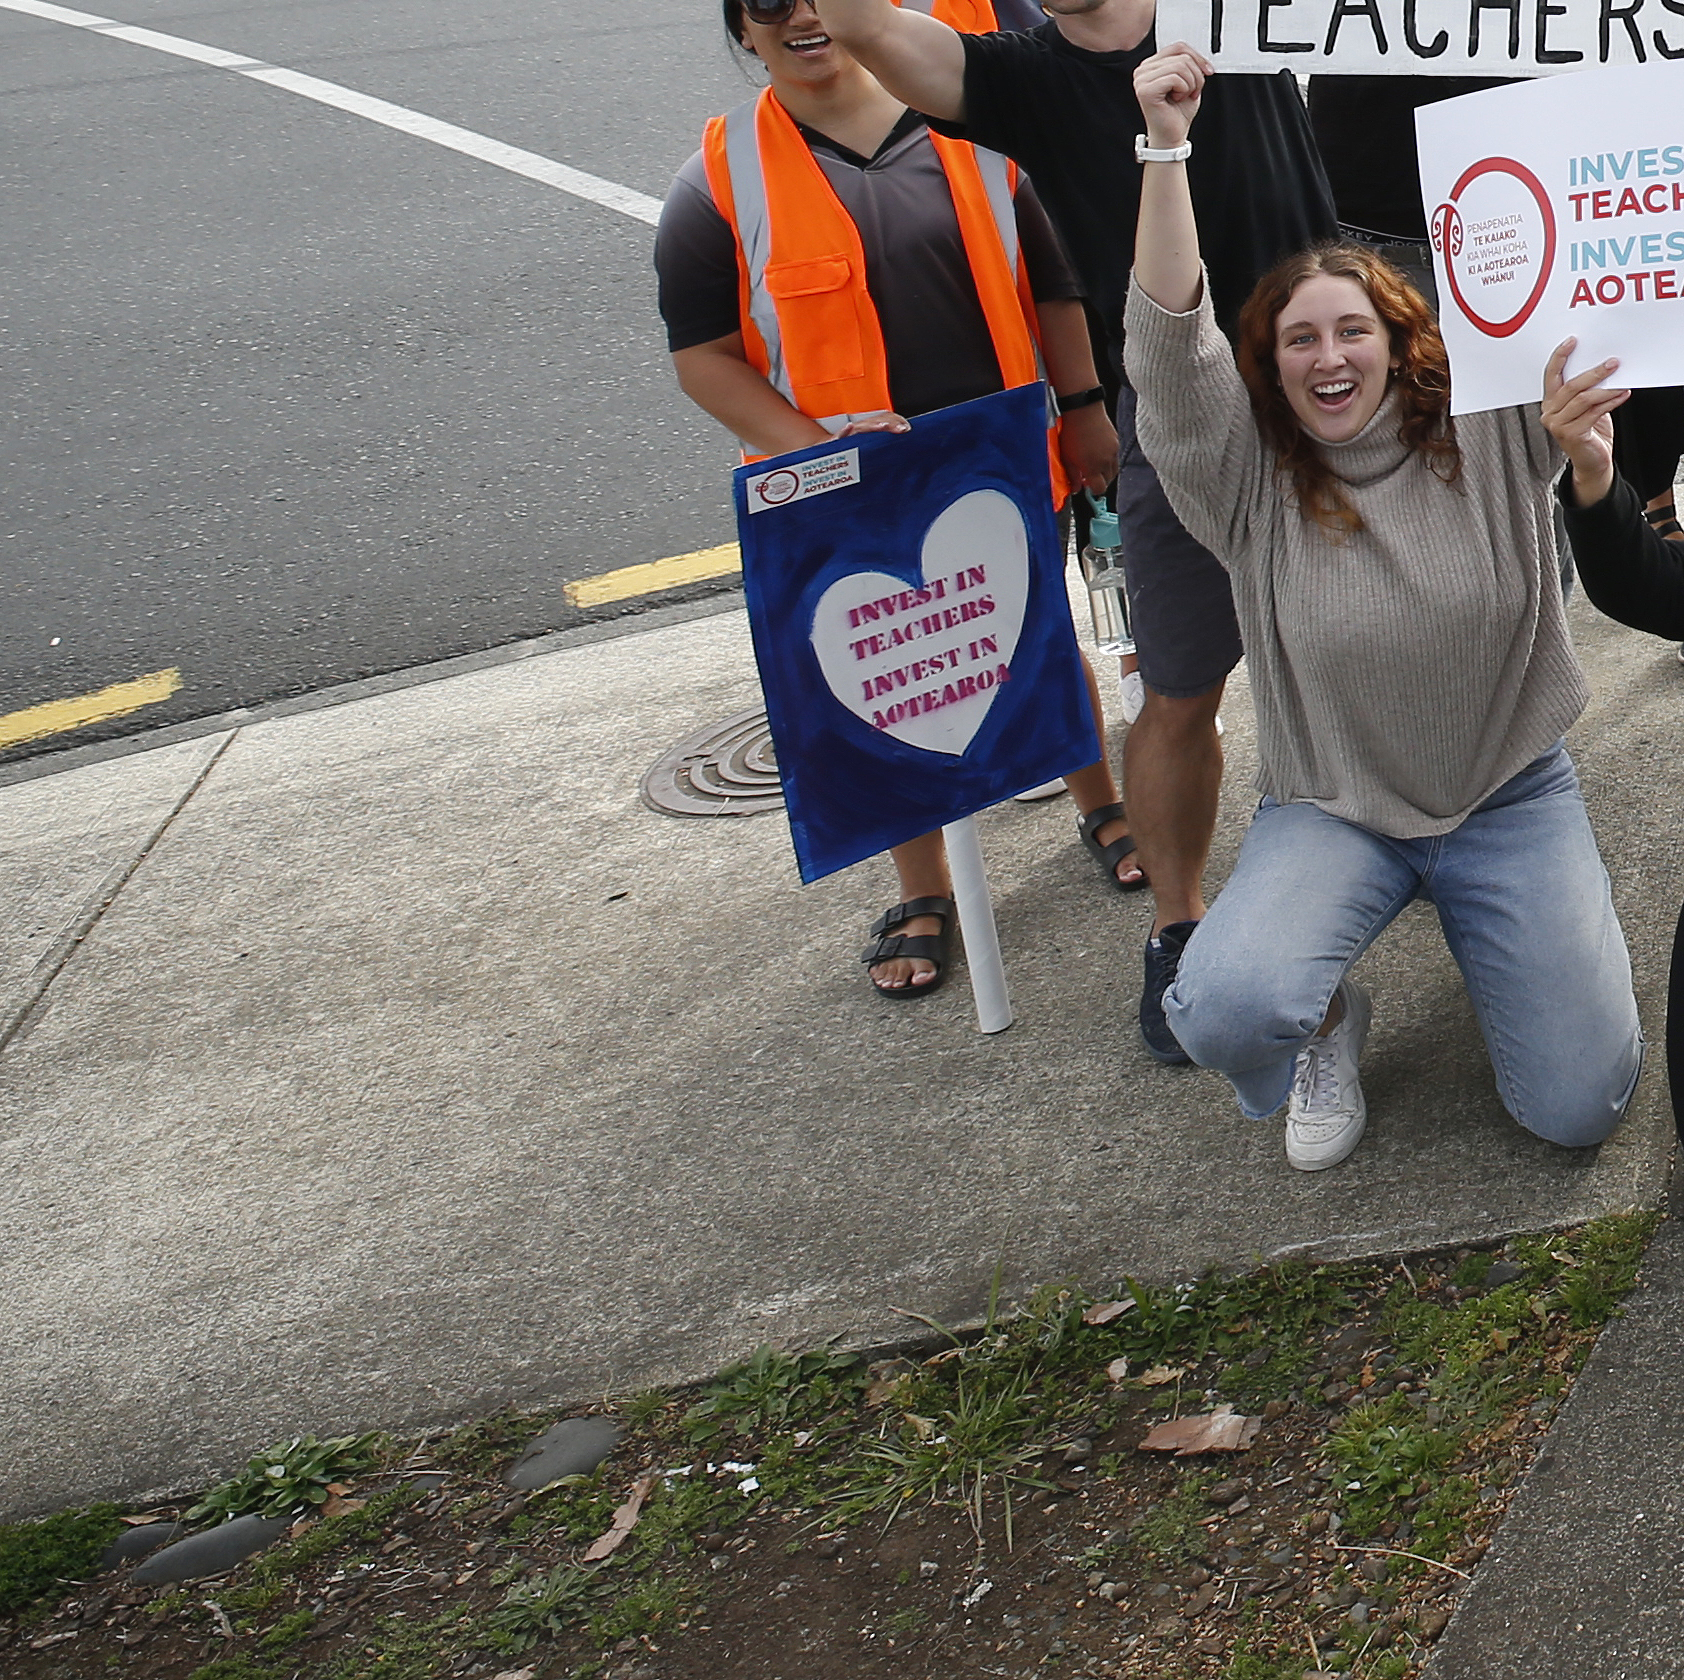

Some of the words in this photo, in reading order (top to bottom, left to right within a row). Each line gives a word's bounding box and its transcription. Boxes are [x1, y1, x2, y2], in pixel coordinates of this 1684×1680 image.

[848, 578, 948, 628] INVEST
[956, 564, 986, 591] IN
[850, 594, 996, 660] TEACHERS
[862, 648, 960, 701] INVEST
[968, 634, 998, 660] IN
[871, 663, 1012, 730] AOTEAROA
